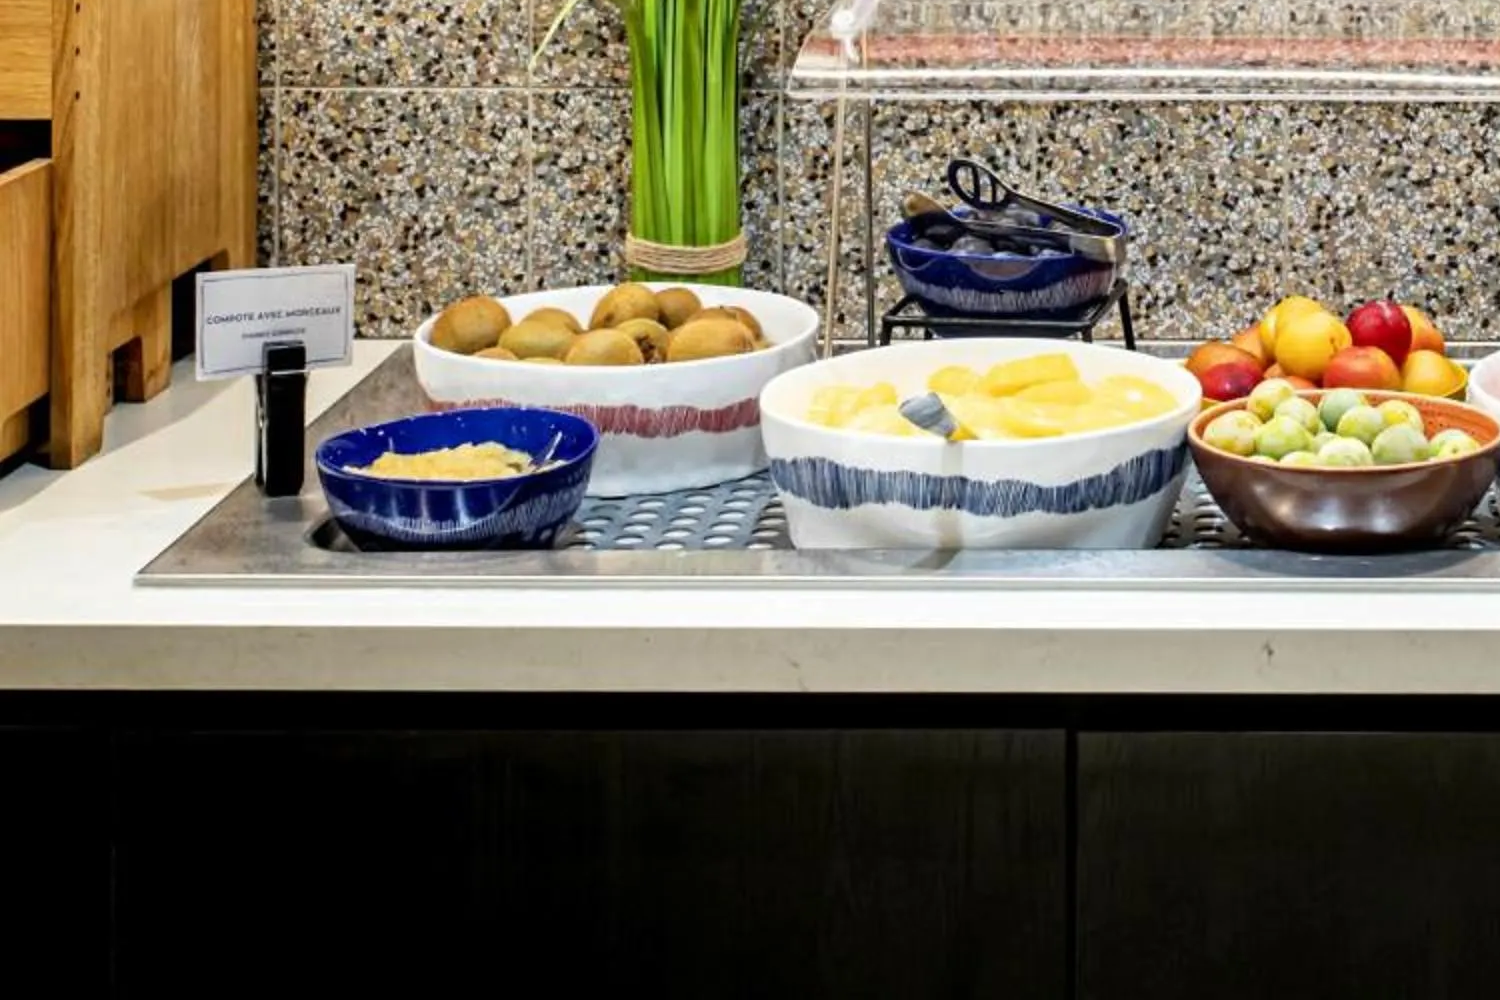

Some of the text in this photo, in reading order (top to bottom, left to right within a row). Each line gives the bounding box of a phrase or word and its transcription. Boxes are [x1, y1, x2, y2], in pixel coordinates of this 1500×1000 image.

[207, 306, 341, 325] COMPOTE AVEC MORCEAUX
